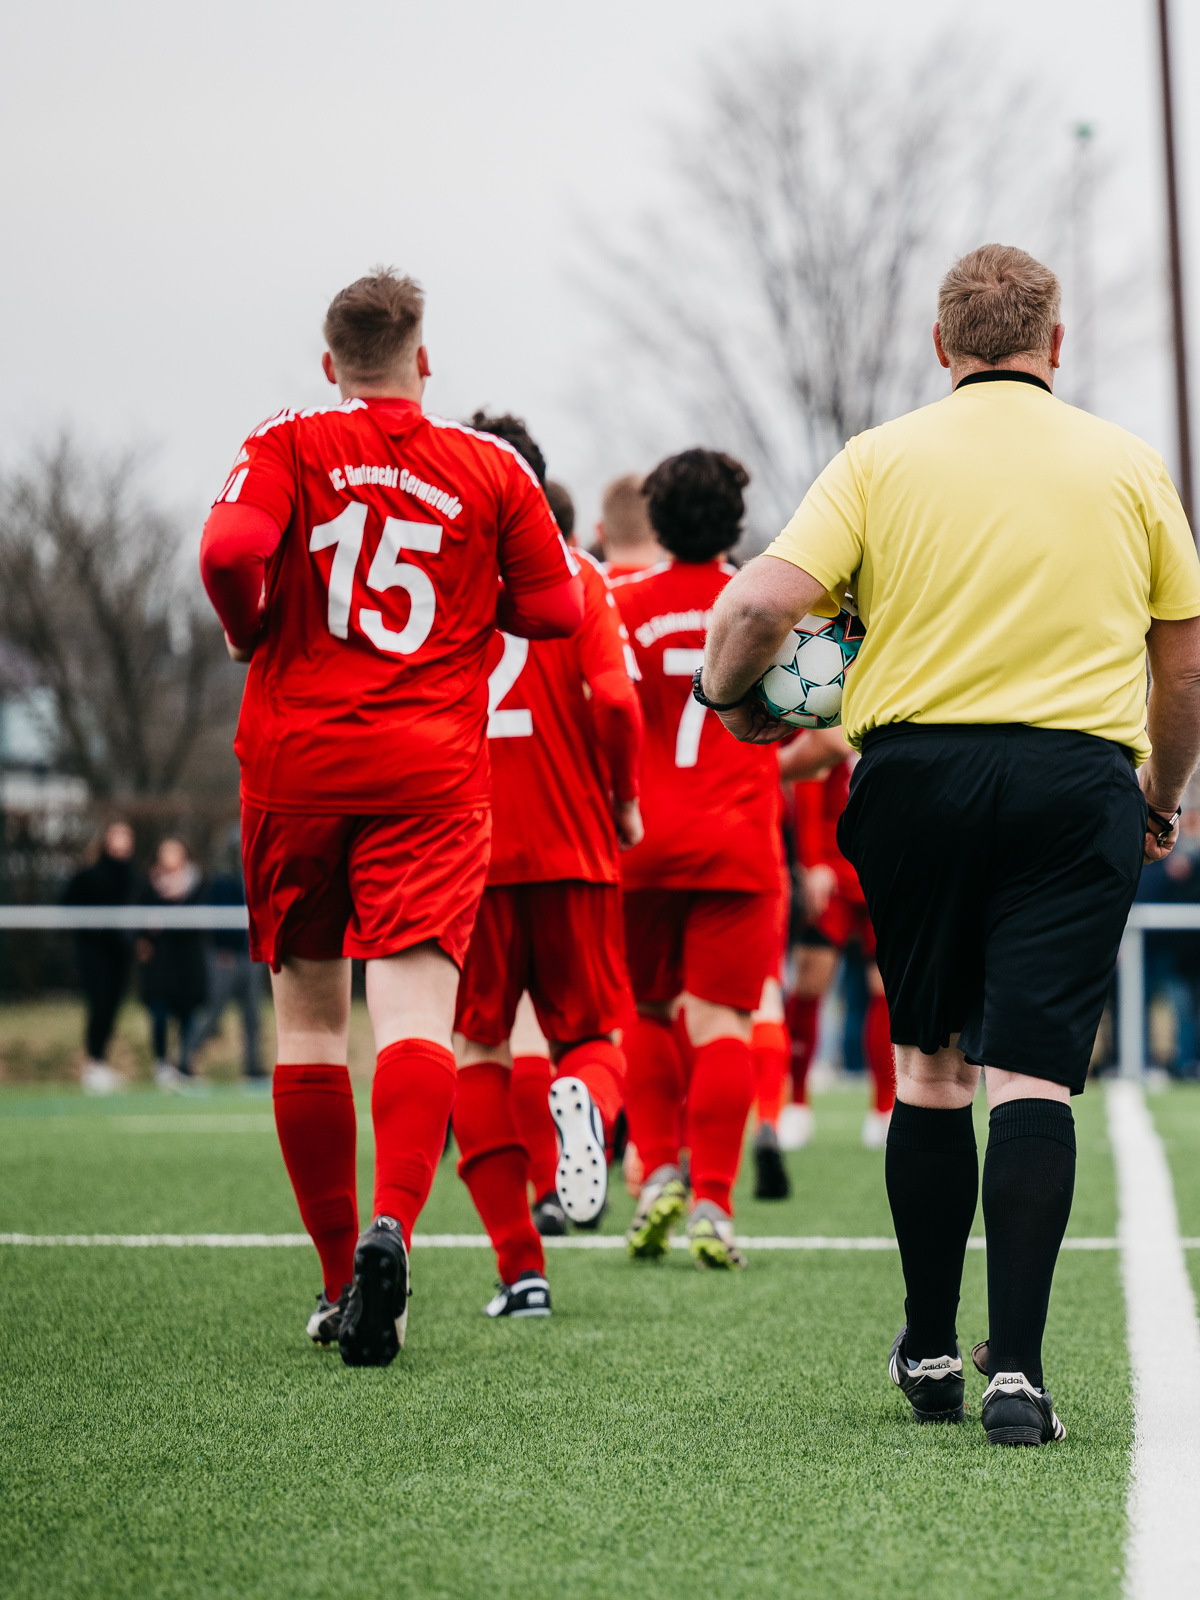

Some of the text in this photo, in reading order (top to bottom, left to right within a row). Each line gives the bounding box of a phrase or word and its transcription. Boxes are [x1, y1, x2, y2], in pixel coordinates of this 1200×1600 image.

[309, 500, 444, 655] 15
[662, 648, 707, 768] 7
[921, 1362, 951, 1371] adidas
[994, 1376, 1024, 1386] adidas
